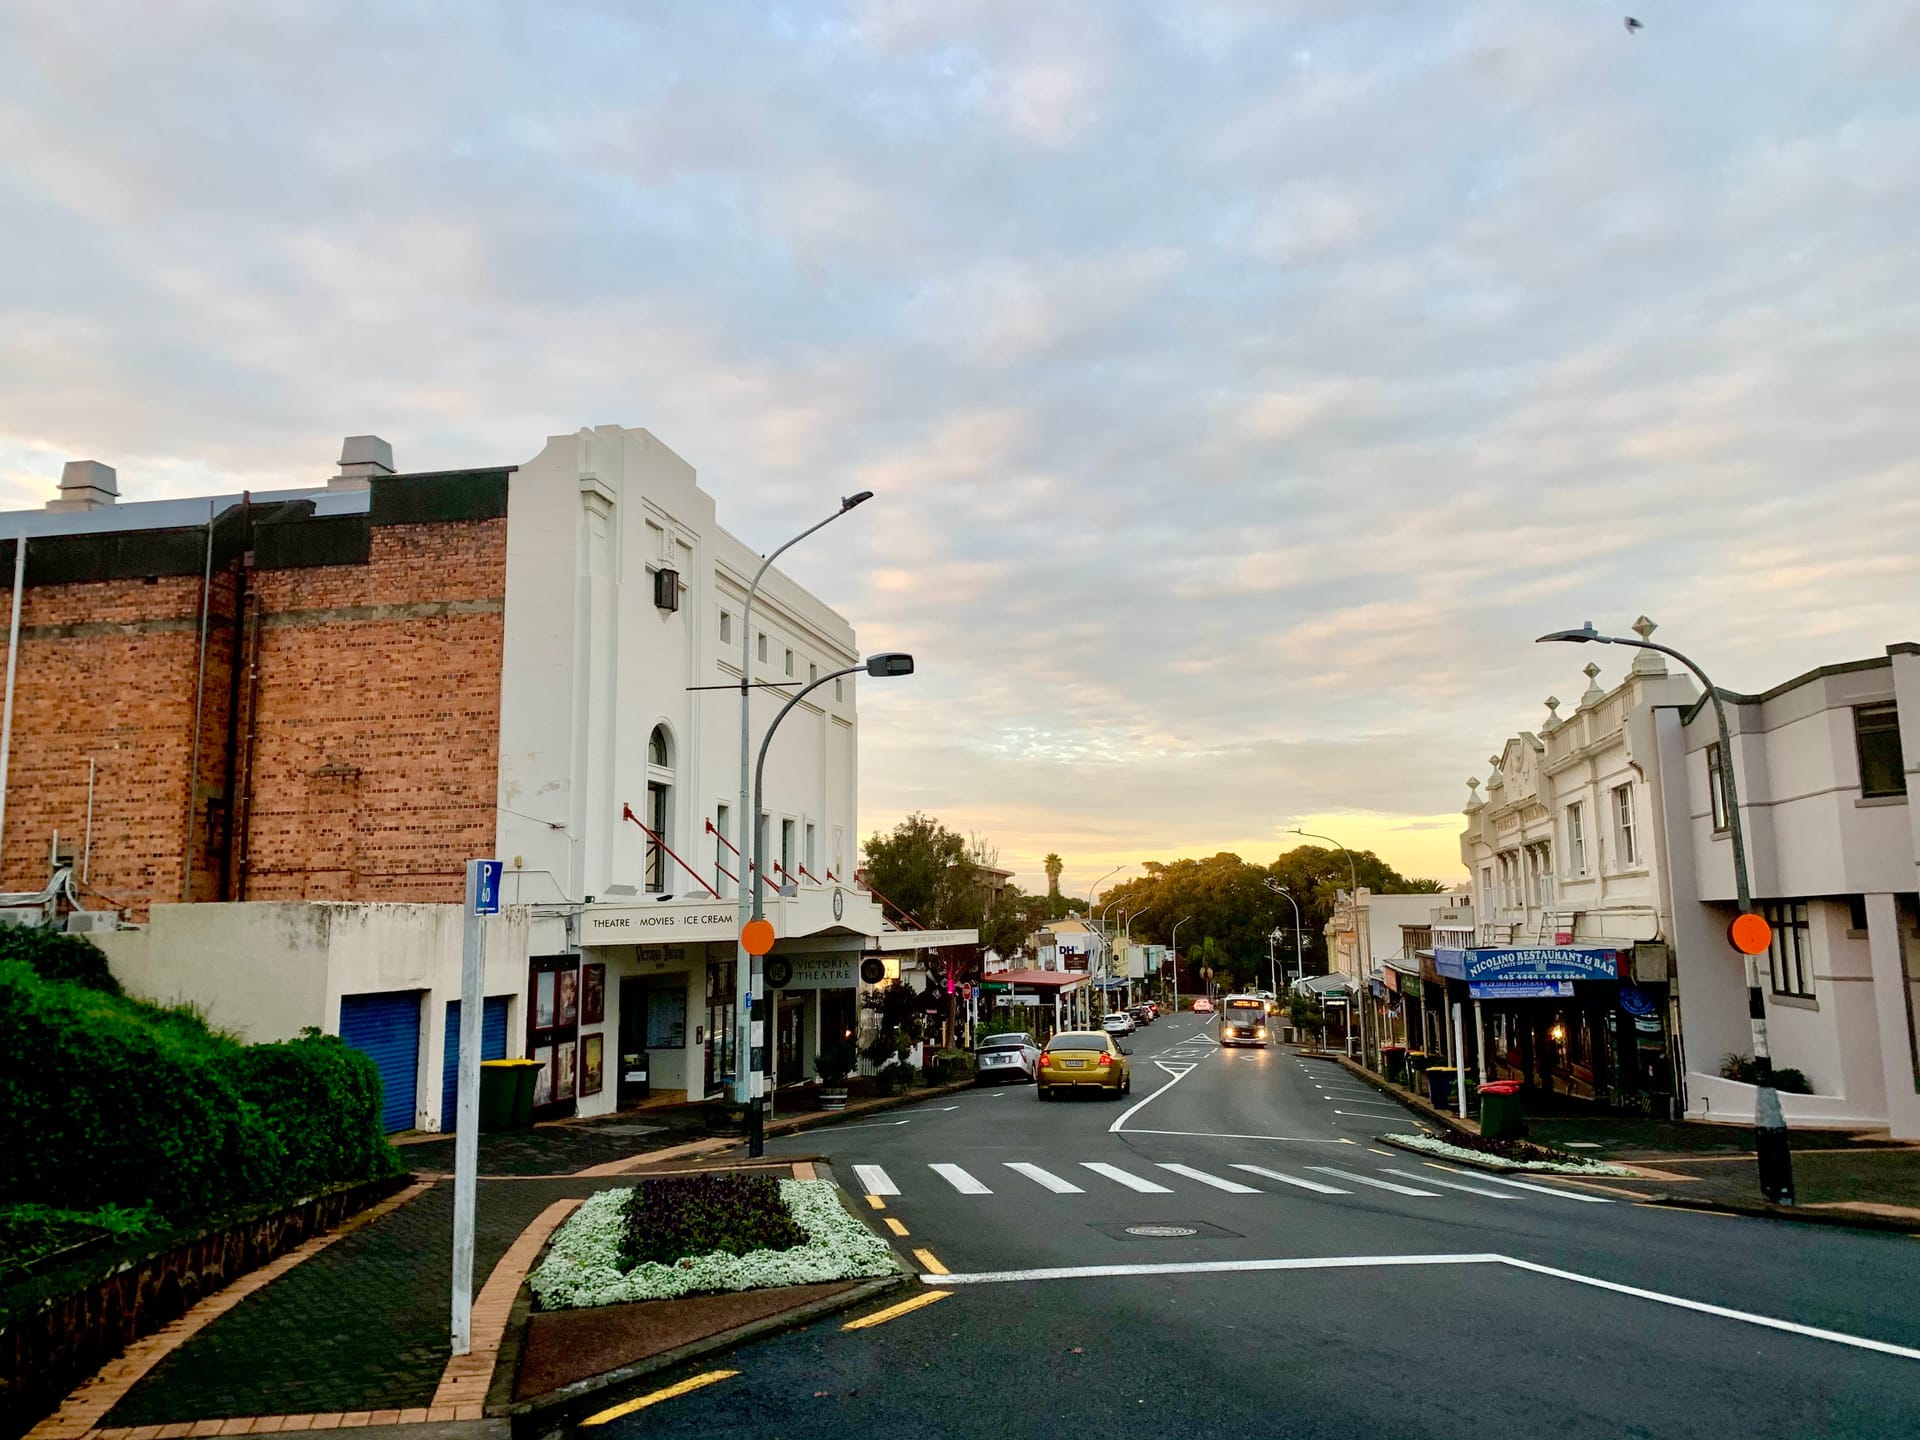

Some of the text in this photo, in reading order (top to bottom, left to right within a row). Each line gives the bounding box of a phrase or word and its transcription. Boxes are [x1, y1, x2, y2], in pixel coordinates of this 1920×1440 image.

[484, 864, 492, 884] P
[481, 887, 491, 903] 60
[593, 918, 630, 928] THEATRE
[639, 917, 675, 926] MOVIES
[683, 916, 698, 925] ICE
[701, 915, 733, 924] CREAM
[796, 959, 850, 969] VICTORIA
[1470, 953, 1515, 978] NICOLINO
[1516, 950, 1582, 963] RESTAURANT
[1584, 955, 1593, 965] &
[1594, 958, 1615, 977] BAR
[797, 970, 850, 981] THEATRE
